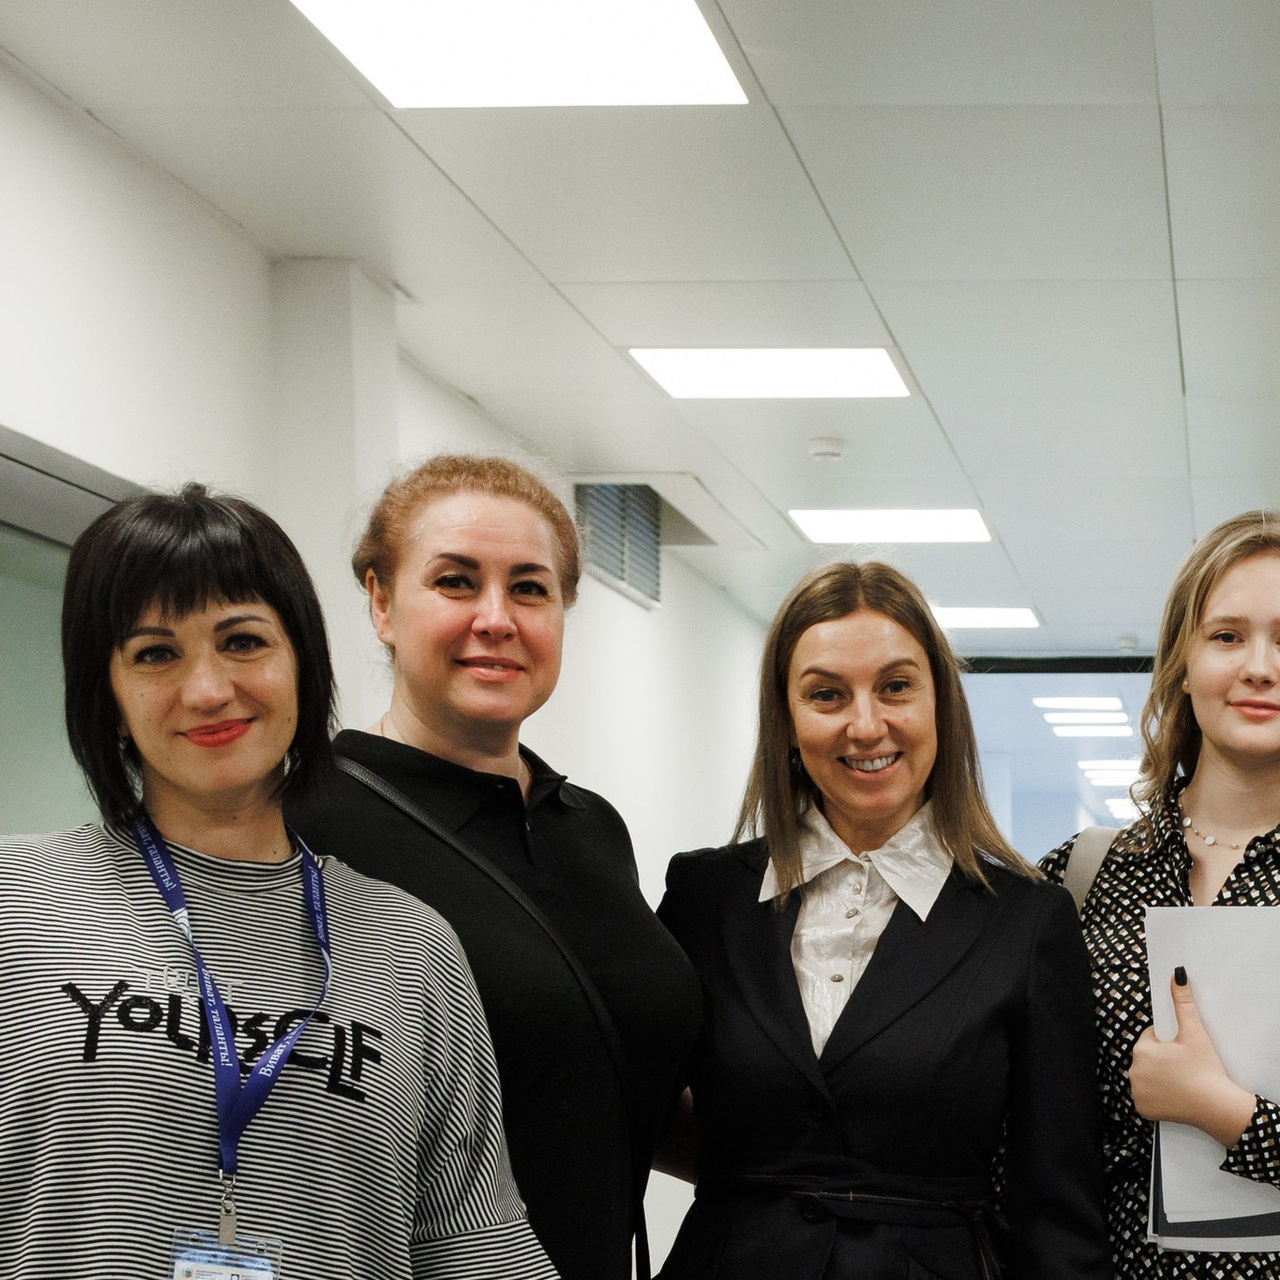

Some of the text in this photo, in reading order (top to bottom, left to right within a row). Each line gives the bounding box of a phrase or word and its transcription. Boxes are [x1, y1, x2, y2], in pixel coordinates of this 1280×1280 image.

[147, 844, 178, 891] таланты!
[131, 965, 244, 1004] TRUT
[211, 1010, 233, 1067] таланты!
[258, 1040, 290, 1077] Виват,
